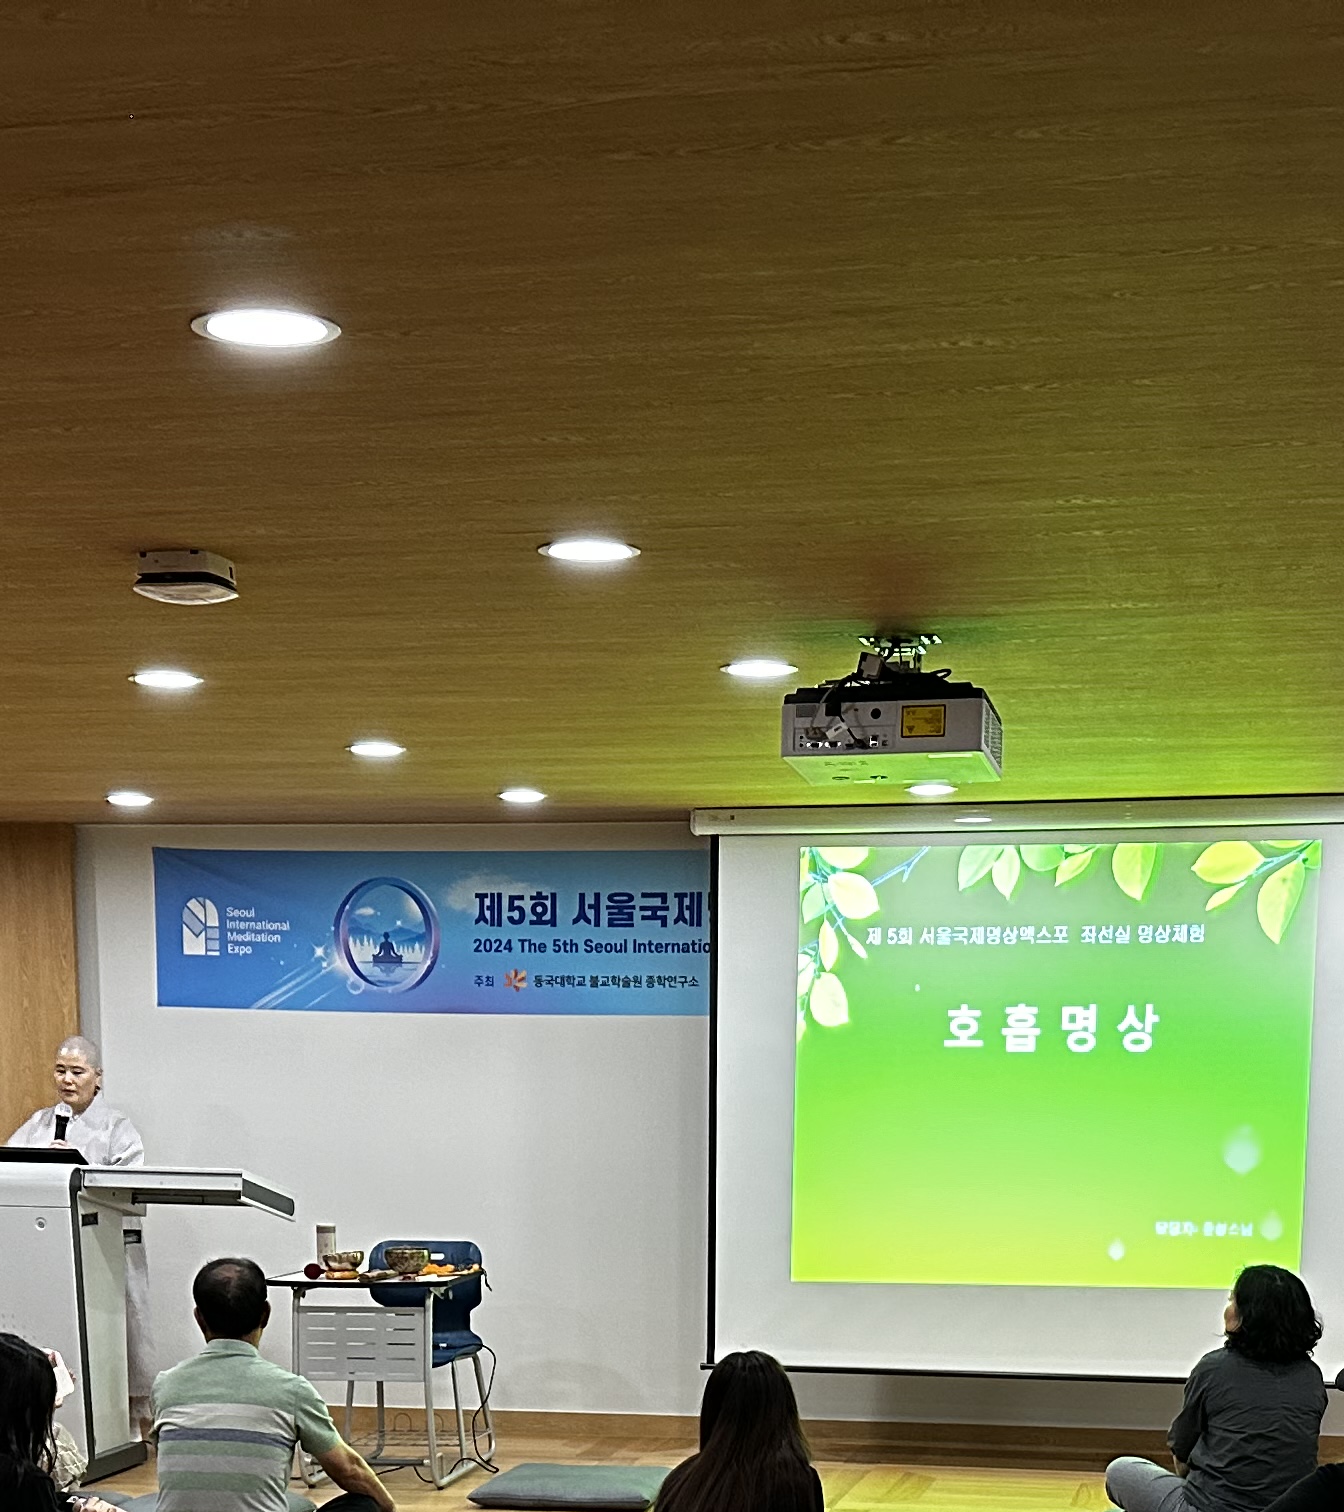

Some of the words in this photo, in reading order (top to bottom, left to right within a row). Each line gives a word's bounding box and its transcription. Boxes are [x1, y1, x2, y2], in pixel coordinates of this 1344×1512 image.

[226, 907, 255, 918] Seoul
[474, 891, 557, 927] 제5회
[572, 891, 710, 928] 서울국제
[226, 920, 290, 931] International
[227, 932, 281, 943] Meditation
[866, 927, 882, 945] 제
[887, 926, 913, 945] 5회
[1080, 925, 1131, 944] 좌선실
[228, 944, 253, 956] Expo
[473, 938, 513, 953] 2024
[518, 938, 547, 953] The
[552, 938, 579, 953] 5th
[583, 938, 628, 954] Seoul
[474, 975, 494, 987] 주최
[533, 975, 586, 988] 동국대학교
